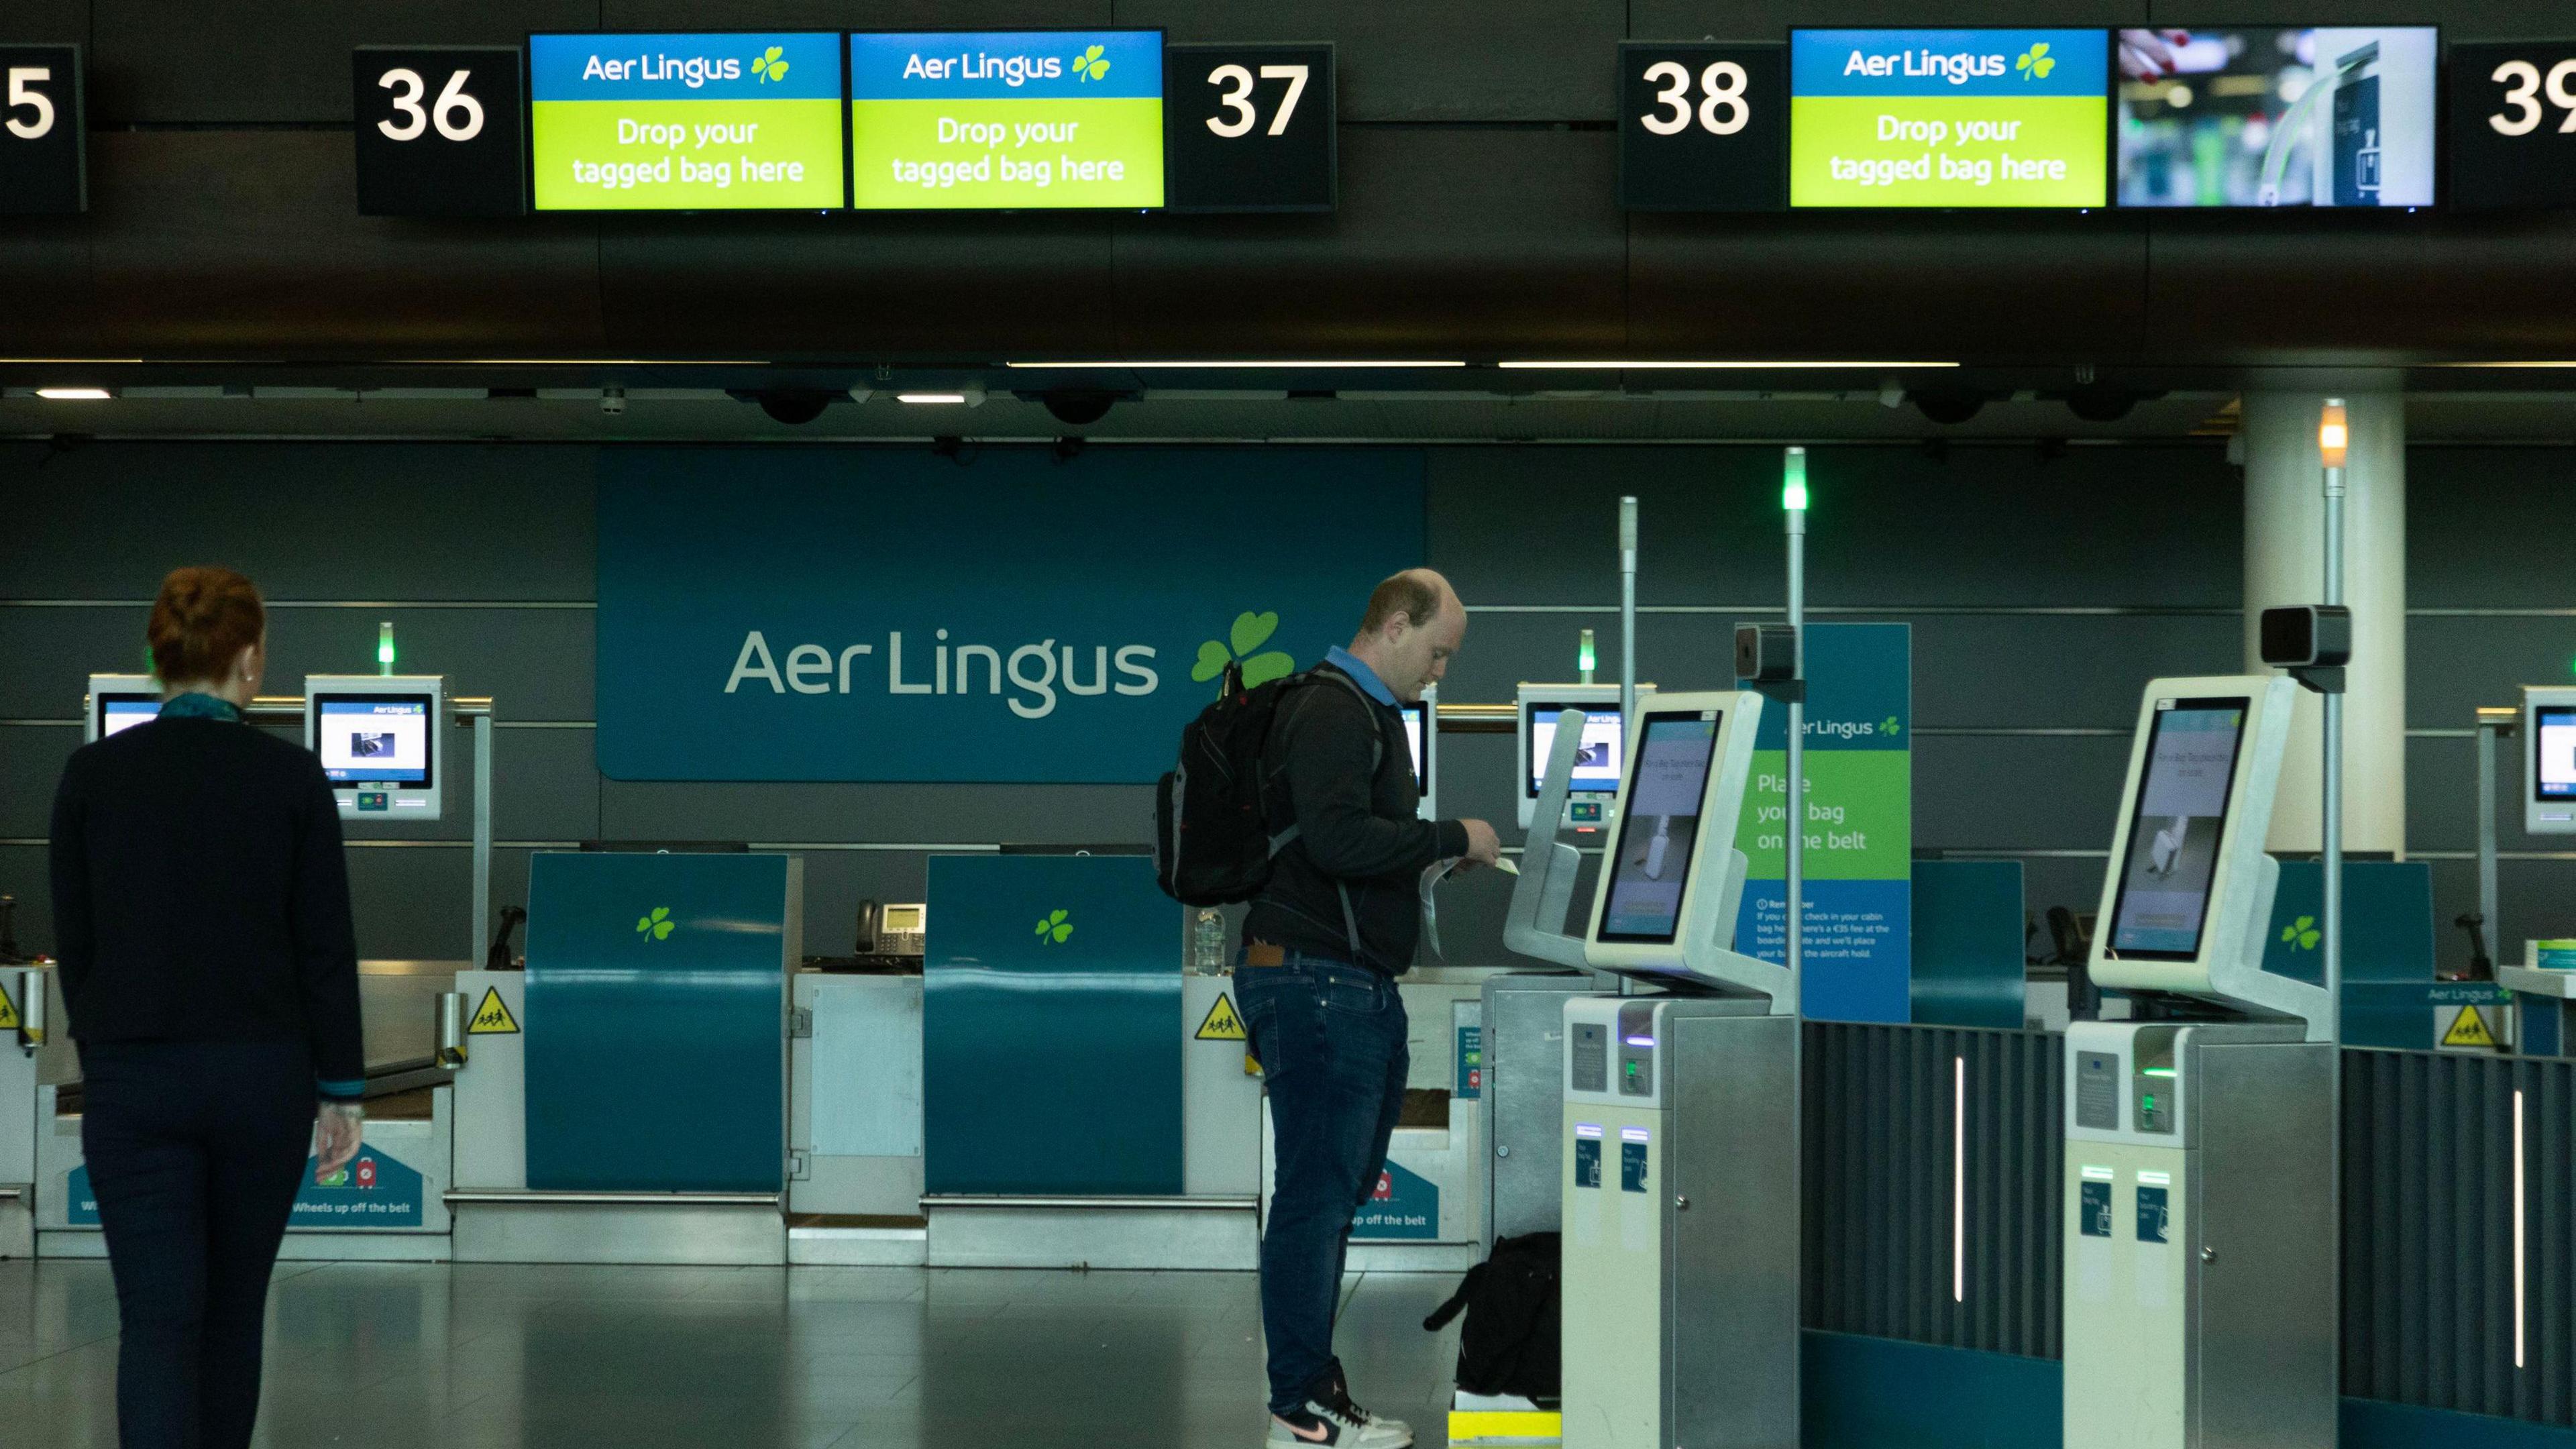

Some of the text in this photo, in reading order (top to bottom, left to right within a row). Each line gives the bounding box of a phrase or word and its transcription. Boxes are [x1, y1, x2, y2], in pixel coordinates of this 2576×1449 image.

[582, 54, 741, 89] Aer Lingus
[902, 52, 1061, 87] Aer Lingus
[1843, 49, 2006, 85] Aer Lingus
[377, 68, 484, 142] 36
[1205, 64, 1309, 138] 37
[1641, 61, 1750, 136] 38
[617, 118, 759, 150] Drop your
[937, 117, 1079, 149] Drop your
[1877, 114, 2022, 148] Drop your
[572, 155, 805, 189] tagged bag here
[892, 154, 1125, 189] tagged bag here
[1829, 152, 2068, 186] tagged bag here
[724, 627, 1159, 719] Aer Lingus
[1817, 720, 1874, 739] Lingus
[1758, 774, 1811, 793] Plae
[1808, 801, 1845, 825] bag
[1758, 835, 1783, 850] on
[1827, 830, 1867, 850] belt
[1757, 924, 1772, 934] bag
[1850, 925, 1864, 933] fee
[1866, 925, 1874, 933] at
[1875, 925, 1890, 933] the
[1765, 914, 1780, 922] you
[1805, 913, 1829, 921] check
[1831, 913, 1839, 921] in
[1841, 914, 1858, 922] your
[1861, 913, 1883, 921] cabin
[1756, 951, 1776, 959] your
[1804, 949, 1819, 958] the
[1819, 949, 1849, 958] aircraft
[1815, 937, 1831, 945] and
[1854, 937, 1876, 947] place
[2428, 989, 2494, 1004] Aer Lingus
[292, 1202, 411, 1214] Wheels up off the belt
[1366, 1214, 1382, 1225] off
[1384, 1214, 1403, 1226] the
[1404, 1215, 1426, 1226] belt
